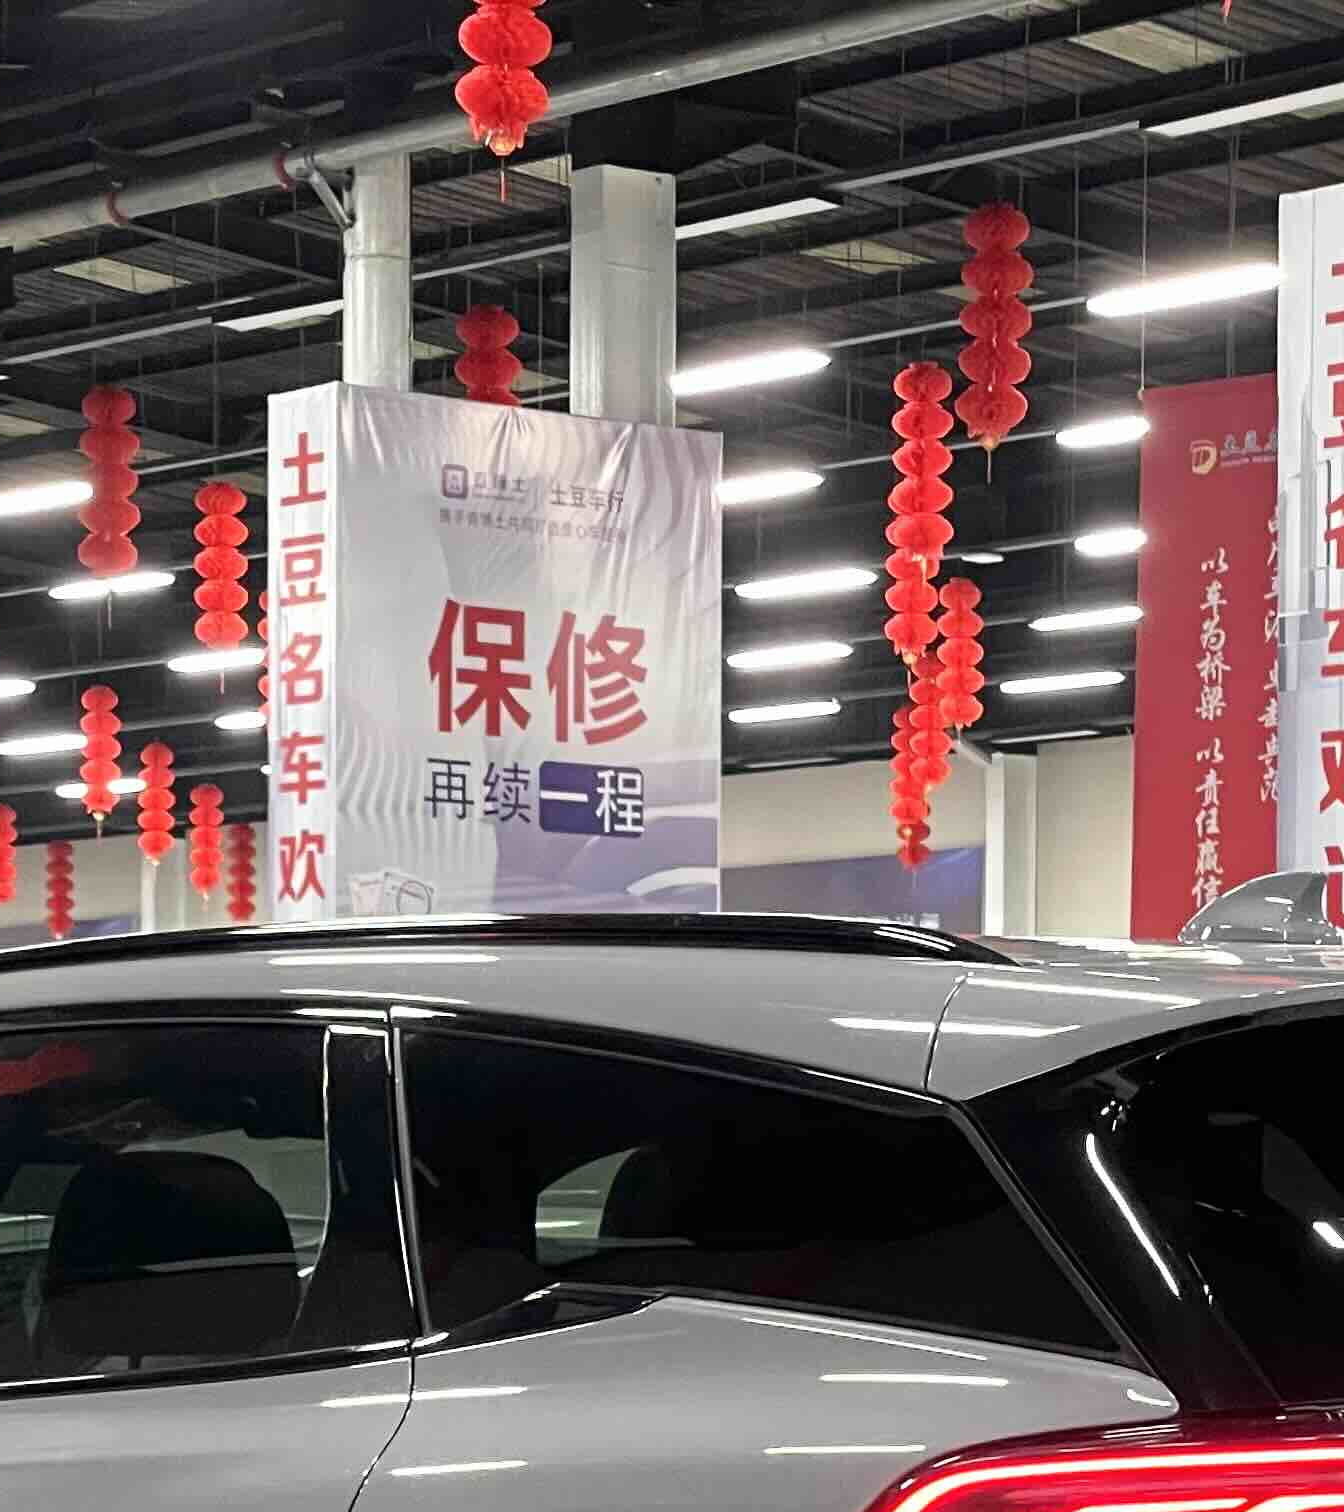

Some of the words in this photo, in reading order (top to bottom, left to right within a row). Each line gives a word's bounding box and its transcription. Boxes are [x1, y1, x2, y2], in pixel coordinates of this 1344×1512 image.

[551, 482, 624, 513] 土豆车行
[278, 432, 327, 903] 土豆名车欢
[428, 599, 649, 745] 保修
[424, 758, 644, 833] 再续一程
